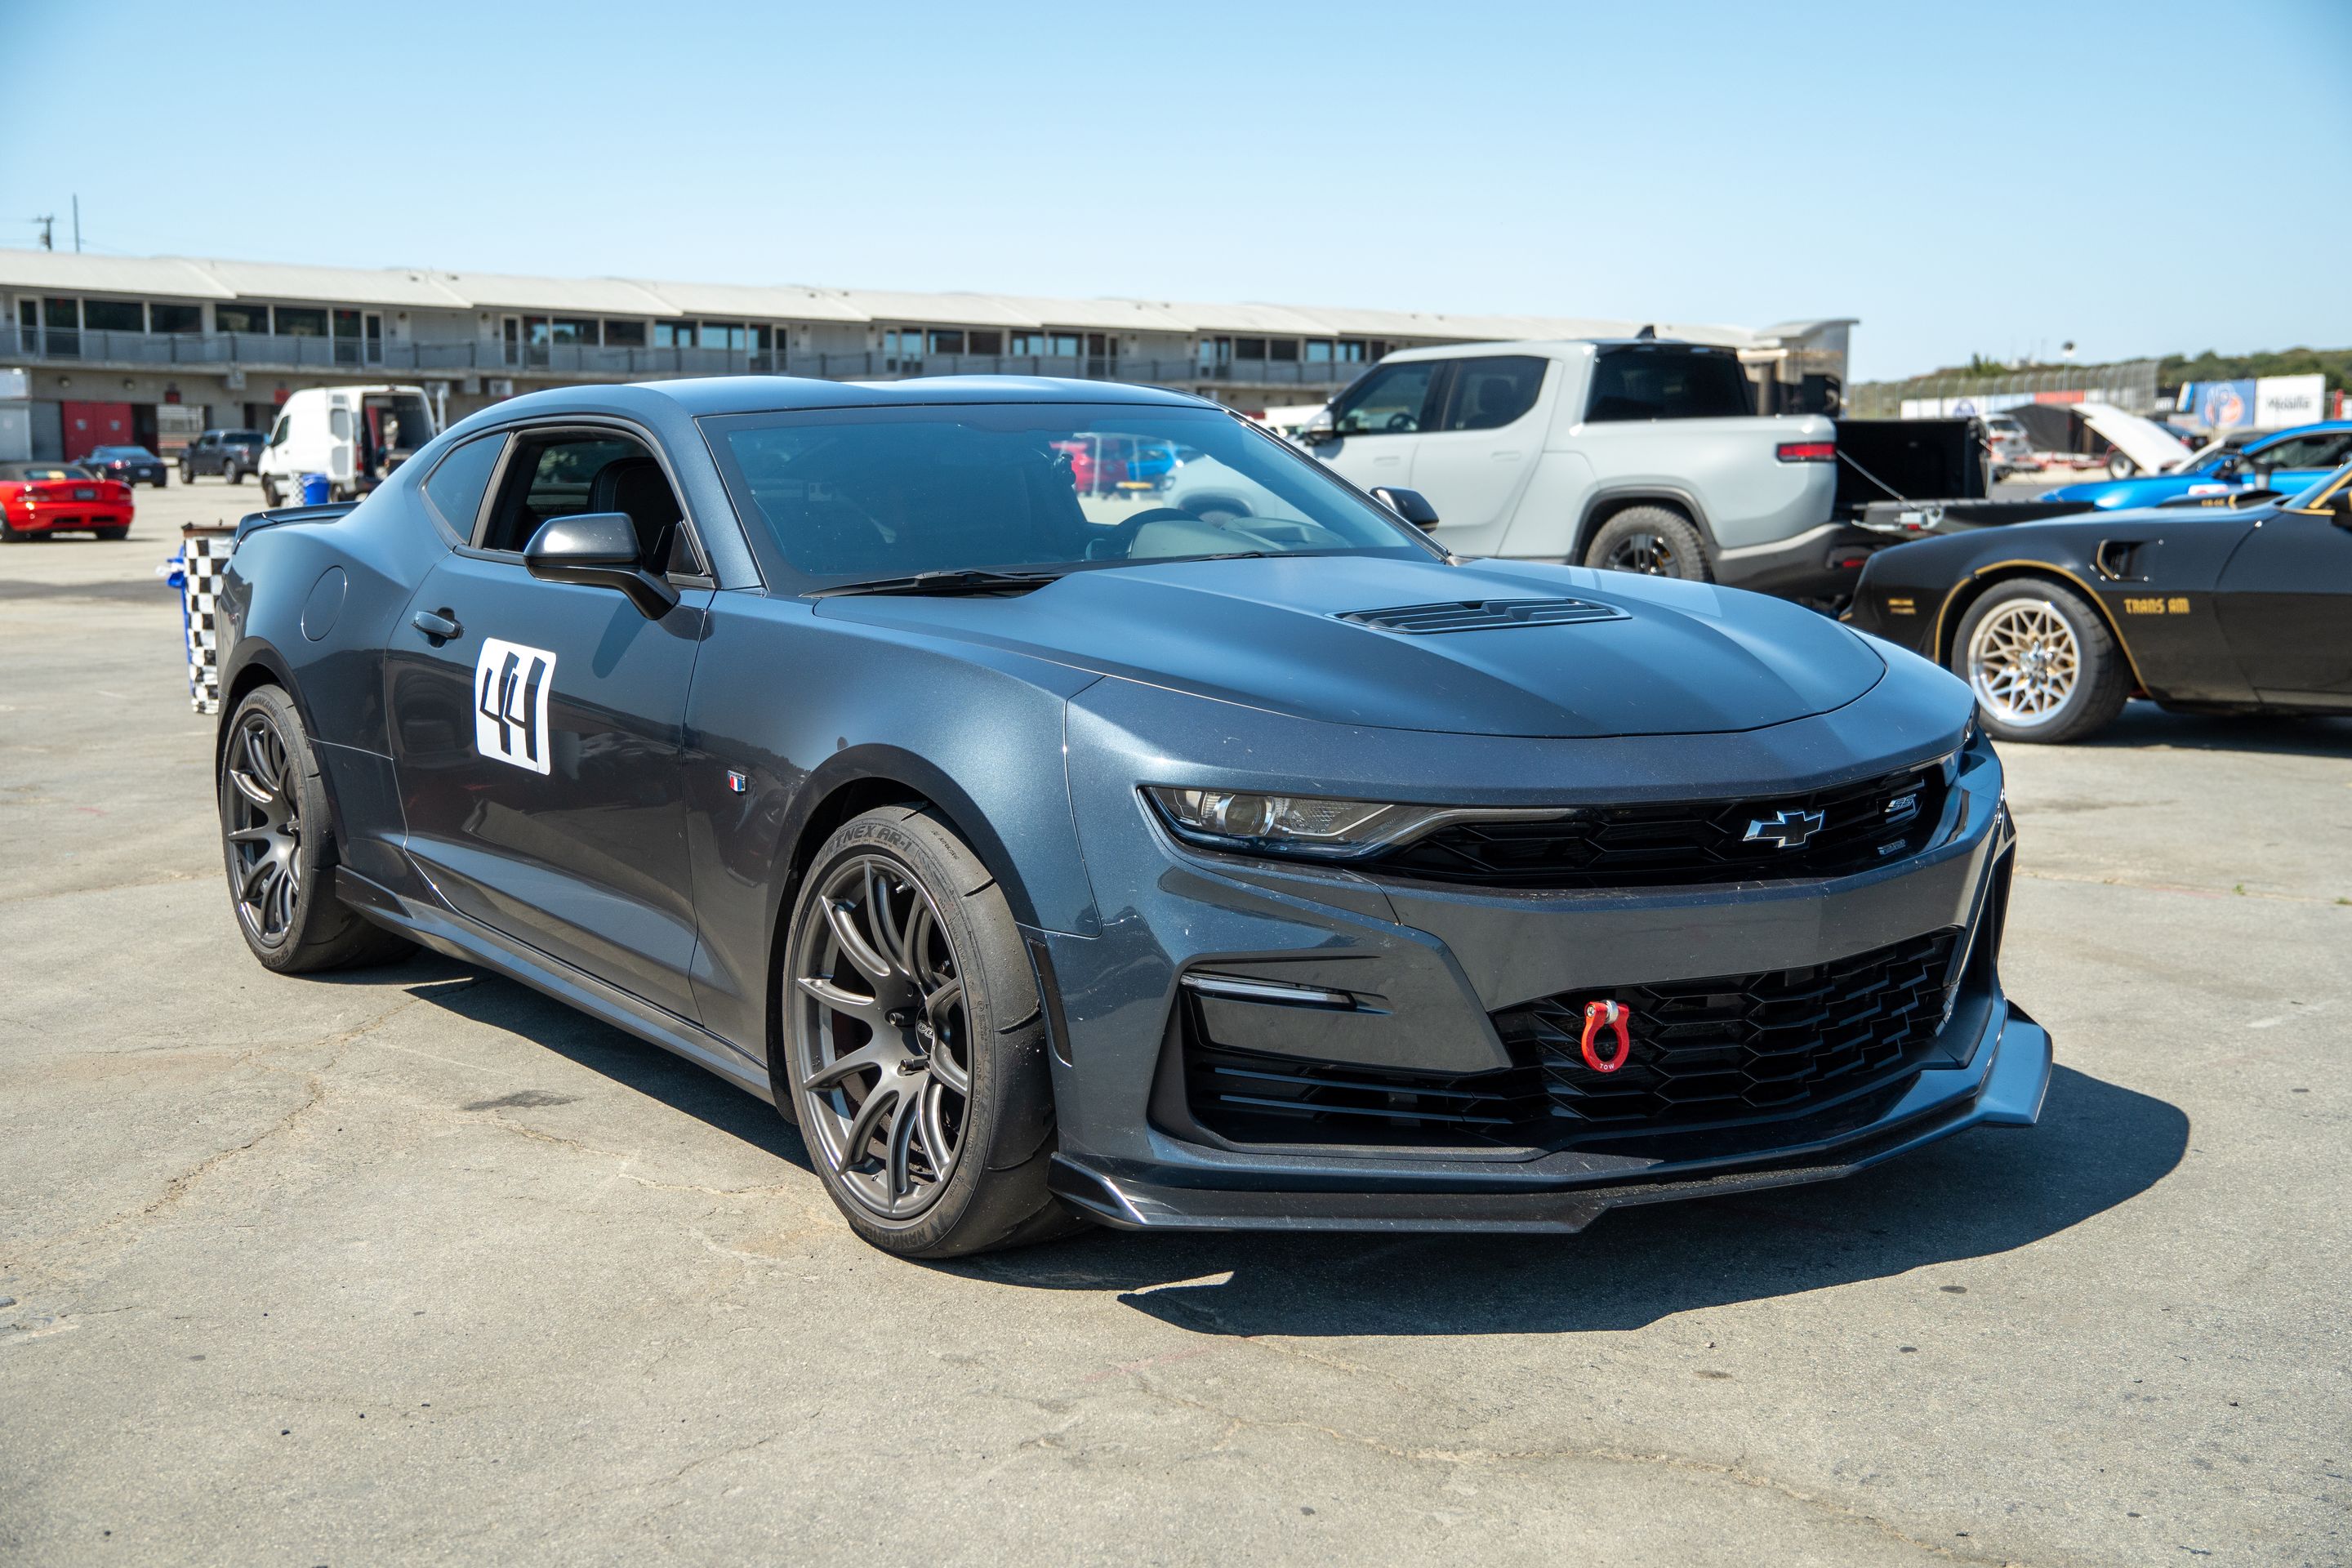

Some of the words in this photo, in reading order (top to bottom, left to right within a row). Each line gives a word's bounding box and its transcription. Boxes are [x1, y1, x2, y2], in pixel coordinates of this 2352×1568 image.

[2124, 598, 2165, 614] TRANS
[2167, 597, 2190, 614] AM
[479, 651, 546, 763] 44
